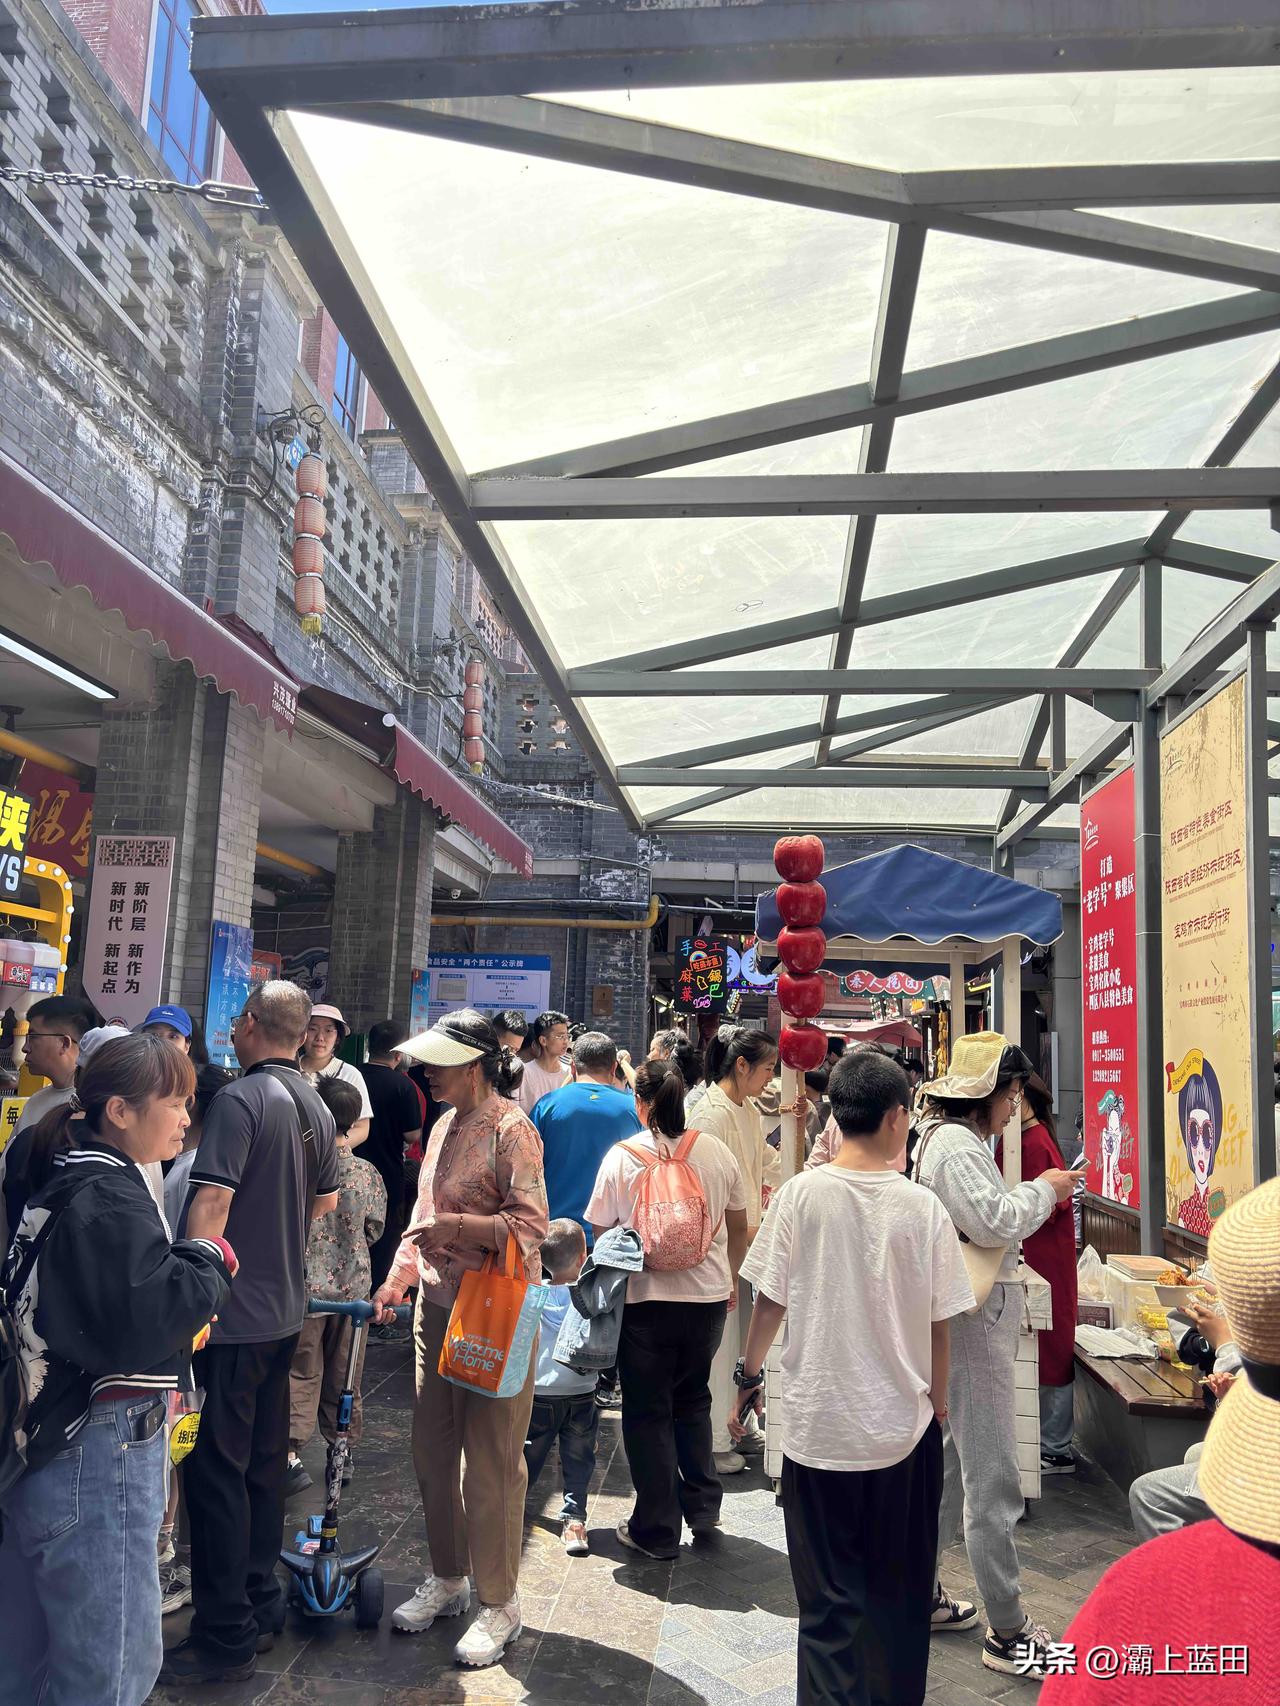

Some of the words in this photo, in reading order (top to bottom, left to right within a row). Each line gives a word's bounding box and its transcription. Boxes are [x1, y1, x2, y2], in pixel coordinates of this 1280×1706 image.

[1100, 855, 1112, 878] 打造
[107, 881, 127, 931] 新时代
[130, 881, 150, 931] 新阶层
[101, 943, 121, 994] 新起点
[124, 943, 144, 994] 新作为
[449, 1335, 505, 1361] Welcome
[453, 1349, 495, 1372] Home
